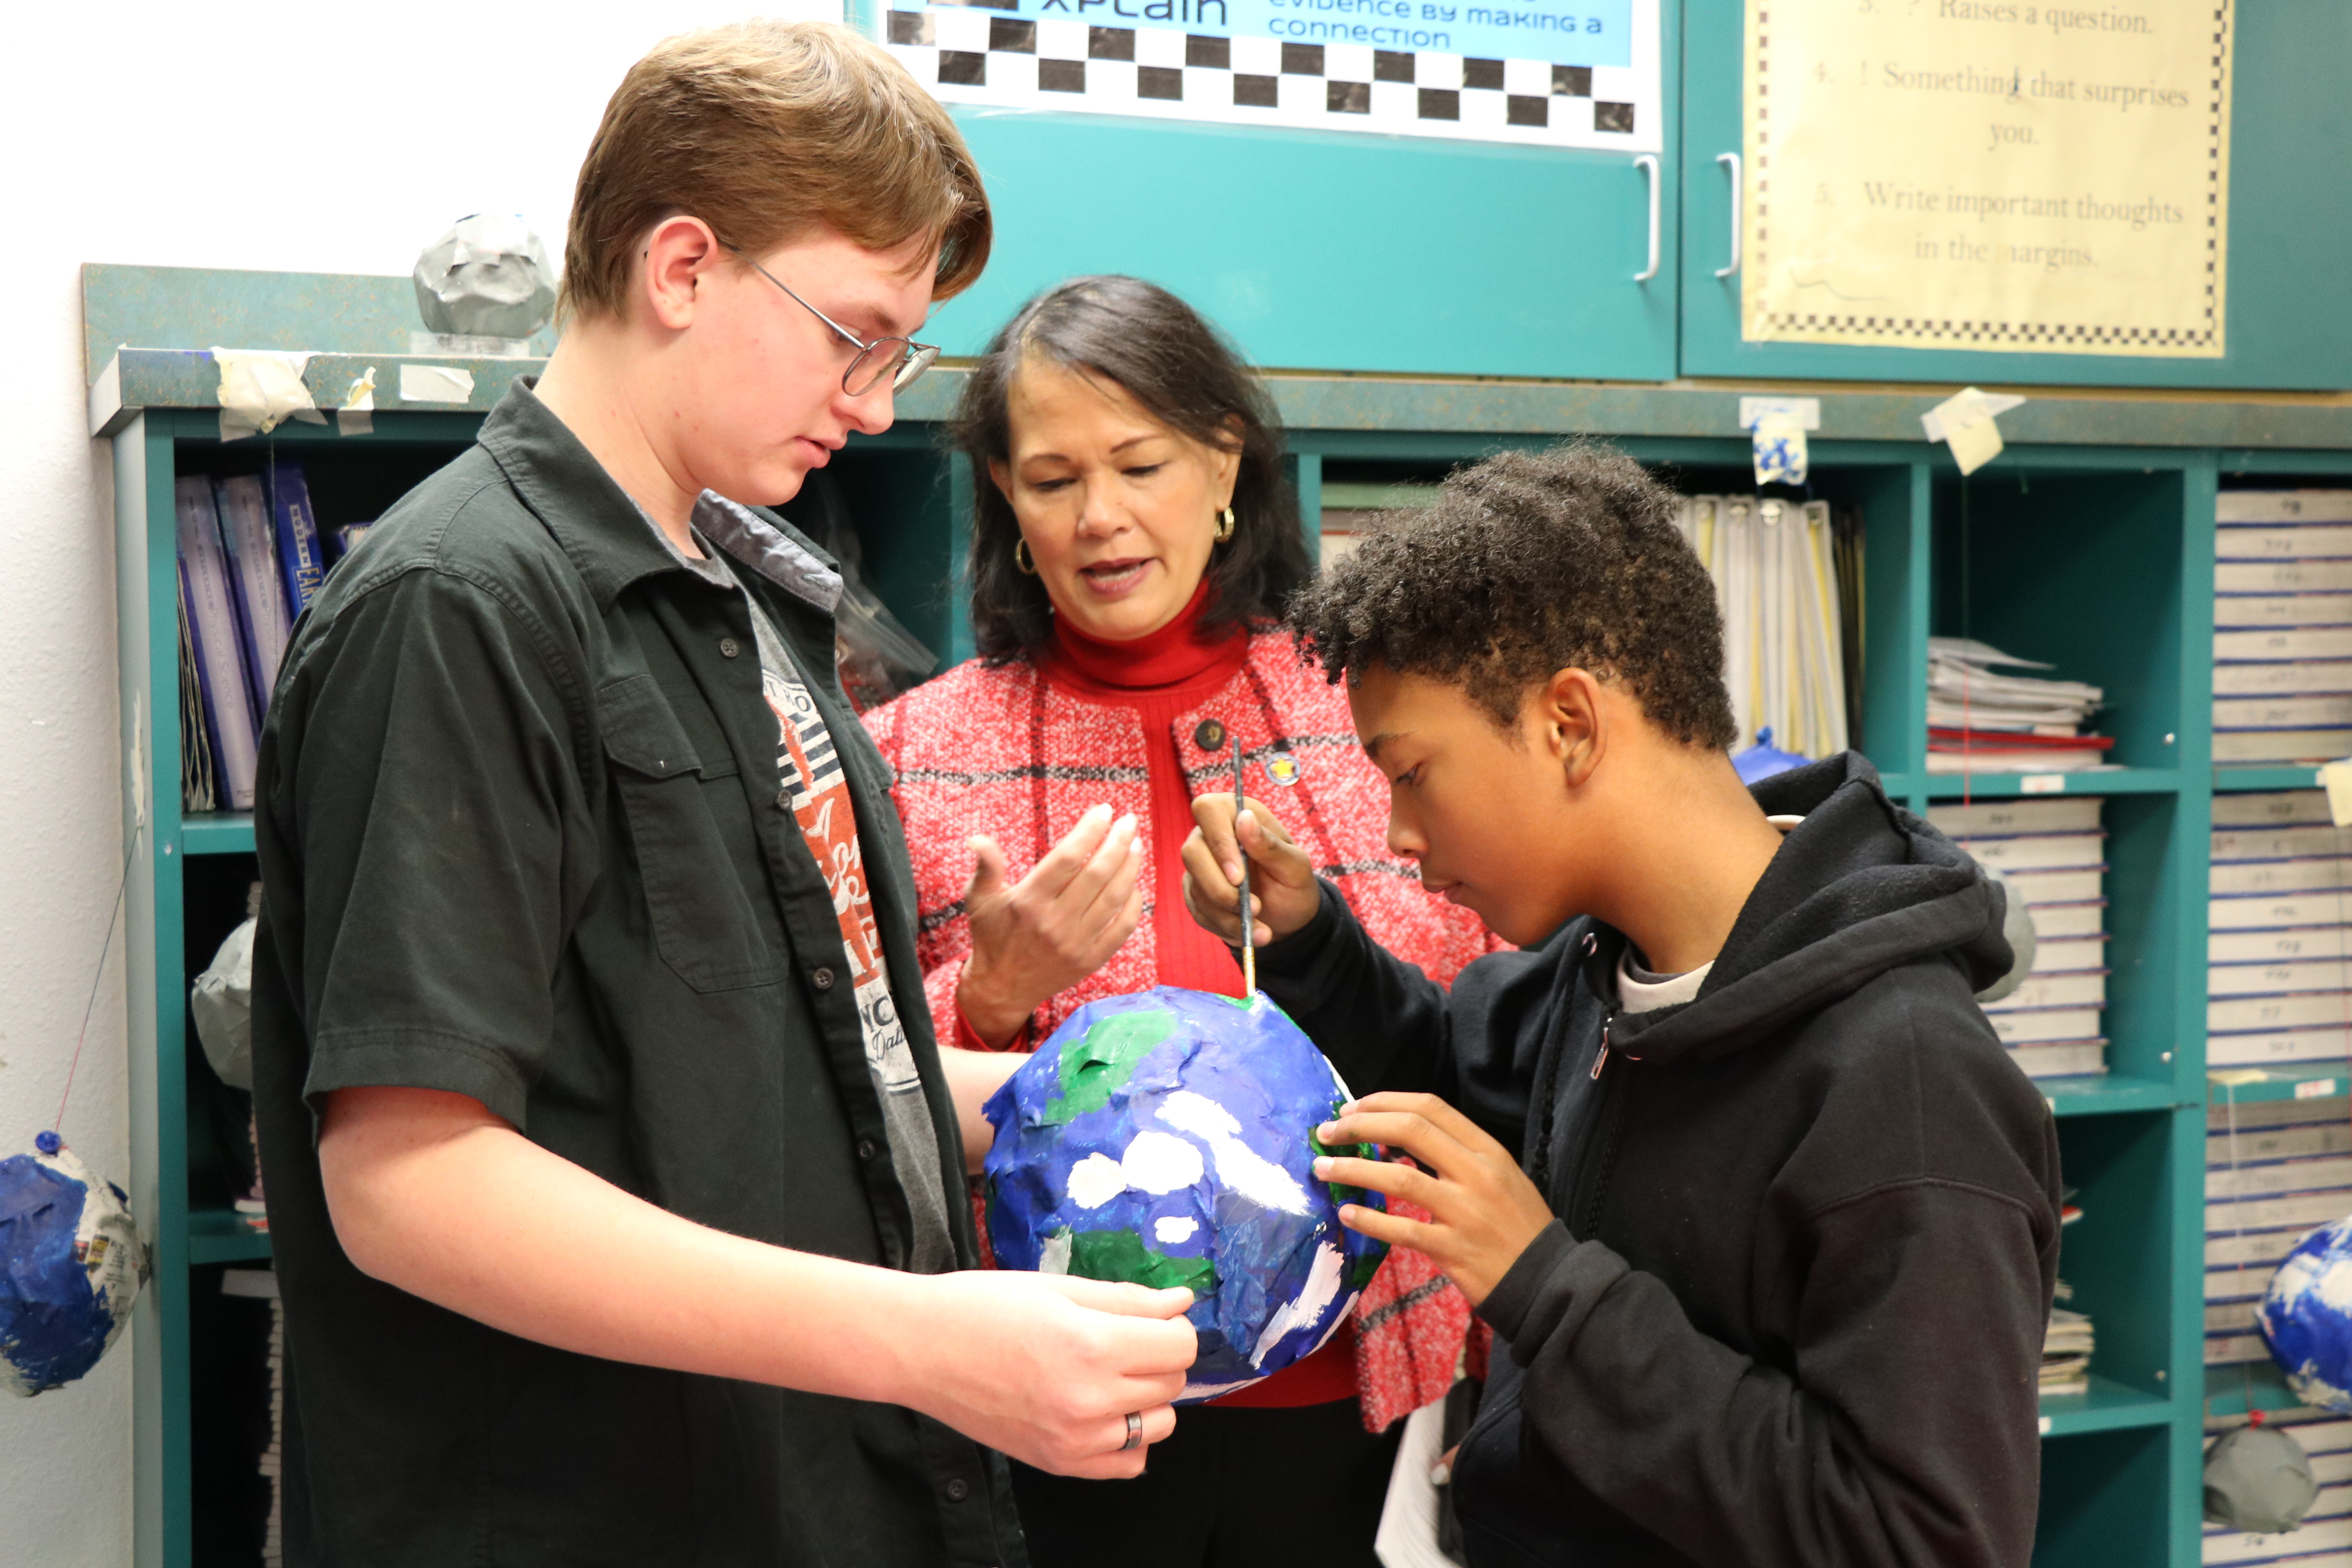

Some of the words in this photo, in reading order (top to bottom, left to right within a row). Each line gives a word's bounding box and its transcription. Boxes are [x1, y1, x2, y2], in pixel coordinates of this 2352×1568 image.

[1586, 17, 1602, 34] a
[1938, 0, 2018, 23] Raises
[2025, 6, 2037, 25] a
[2045, 5, 2154, 35] question.
[1883, 61, 2020, 105] Something
[2031, 70, 2076, 100] that
[2082, 79, 2189, 113] surprises
[1987, 123, 2040, 152] you.
[1862, 181, 1940, 211] Write
[1946, 184, 2069, 222] important
[2076, 192, 2184, 232] thoughts
[1914, 232, 1938, 259] in
[1948, 233, 1989, 262] the
[290, 508, 310, 564] MODERN
[296, 567, 323, 606] EAR
